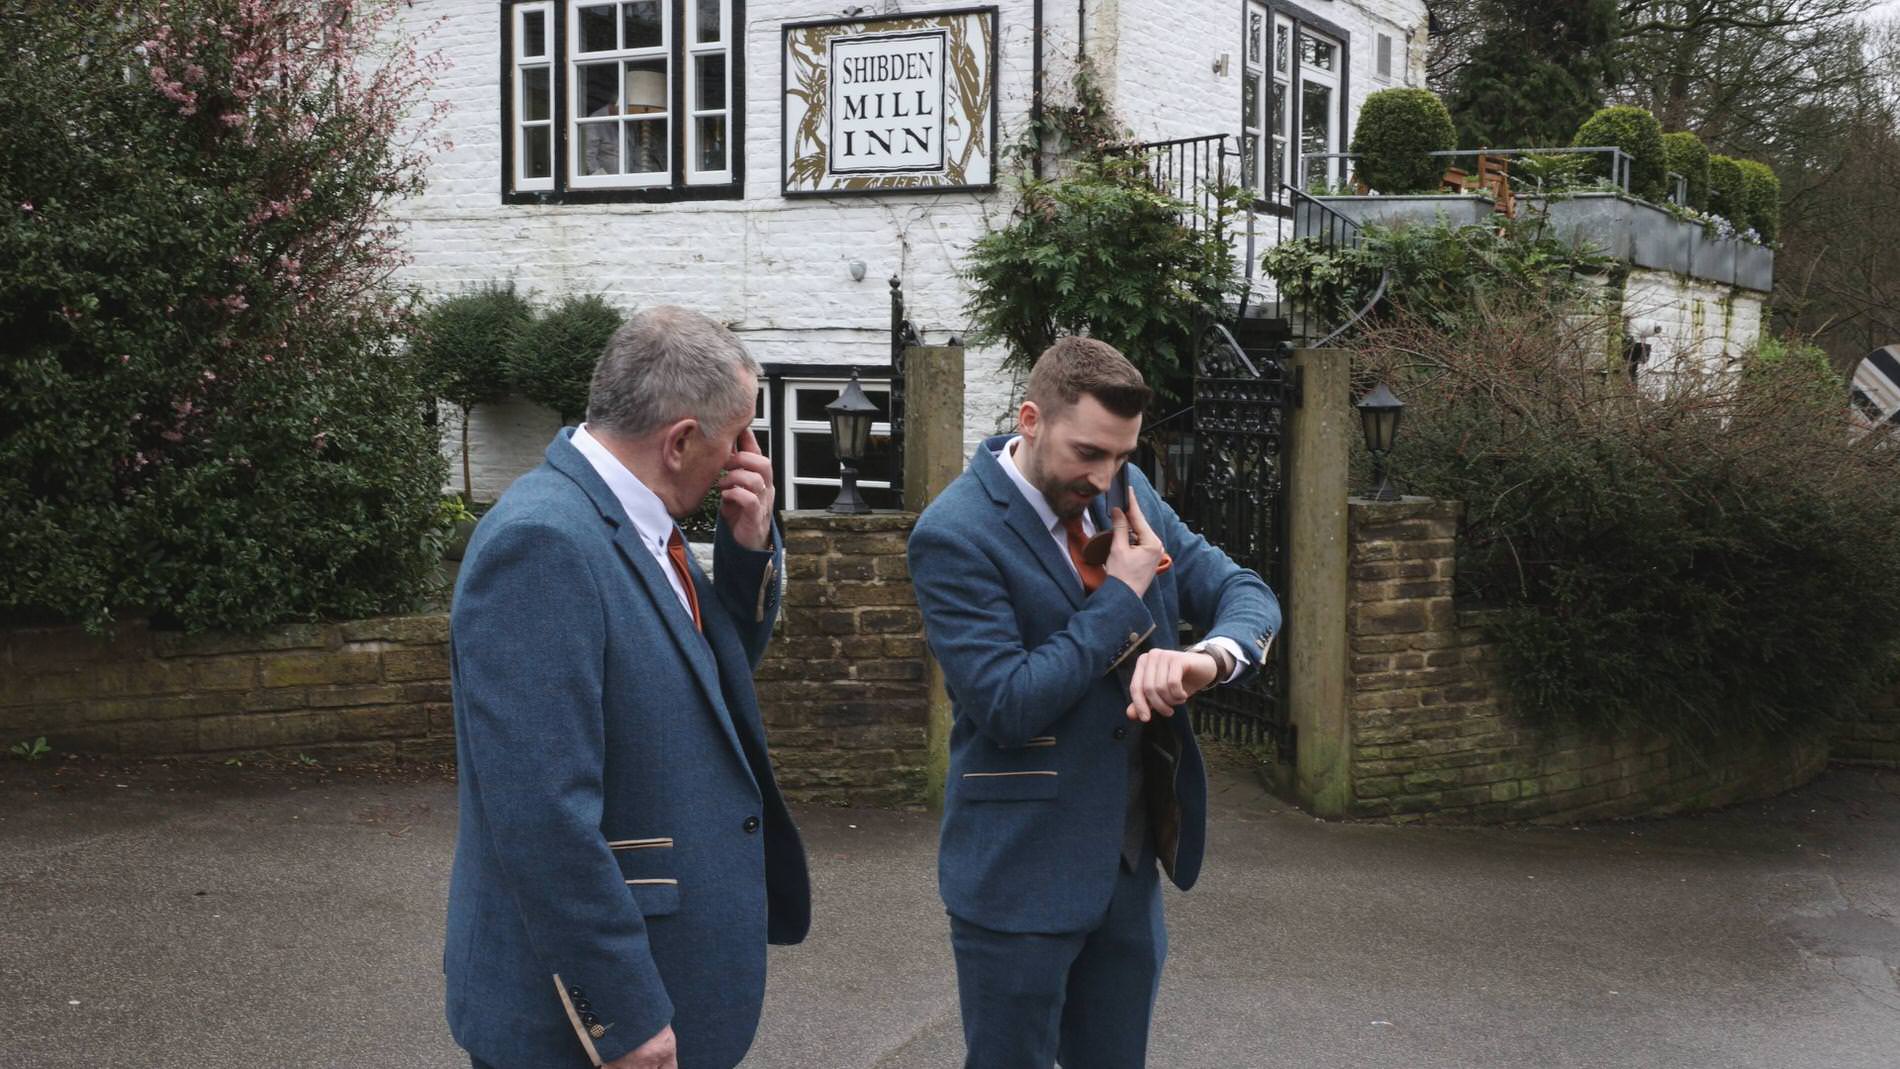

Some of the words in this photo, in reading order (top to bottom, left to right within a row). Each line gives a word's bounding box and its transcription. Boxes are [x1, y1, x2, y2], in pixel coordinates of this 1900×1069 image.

[842, 51, 934, 84] SHIBDEN
[842, 90, 933, 120] MILL
[842, 126, 933, 157] INN
